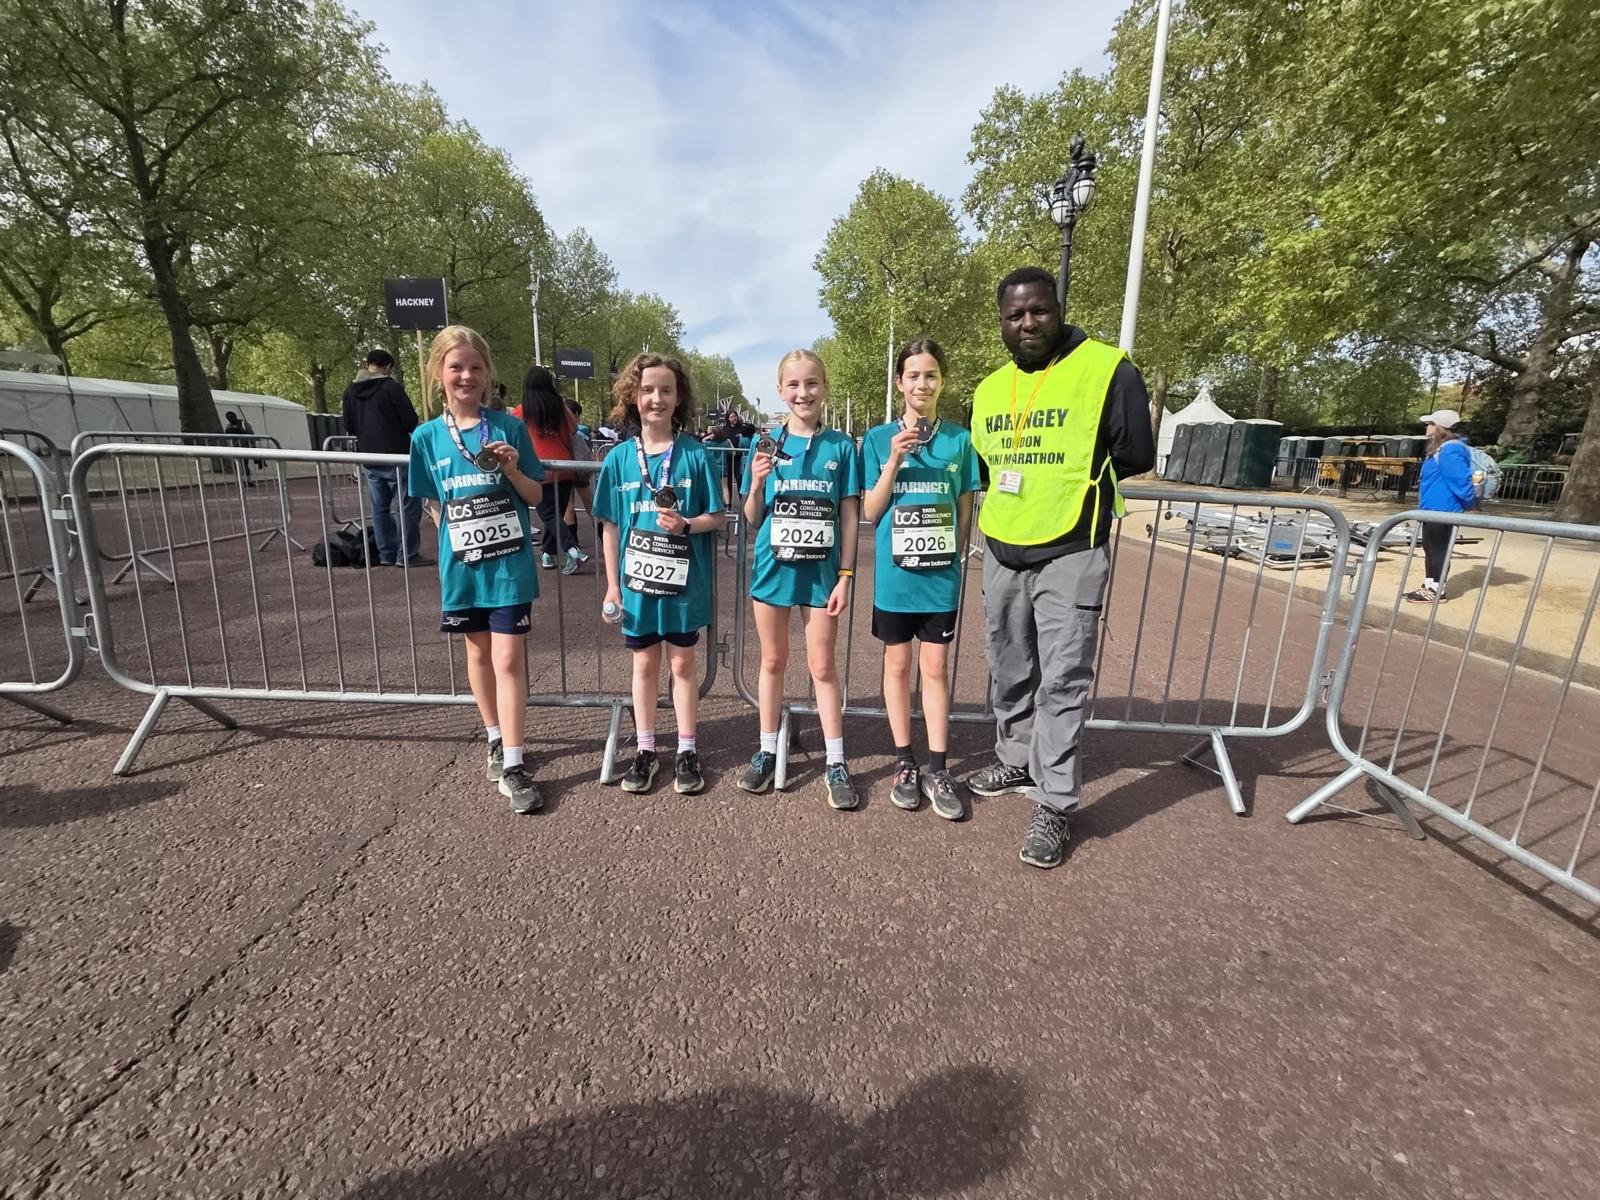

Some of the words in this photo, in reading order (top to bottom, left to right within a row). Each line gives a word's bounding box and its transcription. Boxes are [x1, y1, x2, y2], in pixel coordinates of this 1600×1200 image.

[395, 298, 434, 306] HACKNEY
[985, 408, 1069, 434] HARNGEY
[1001, 436, 1042, 449] LODON
[1003, 452, 1065, 465] MARATHON
[774, 480, 834, 493] HARINGEY
[893, 481, 950, 494] HARINGEY
[473, 498, 510, 509] CONSULTANCY
[774, 500, 797, 515] tcs
[447, 503, 472, 520] tcs
[475, 506, 500, 516] SERVICES
[894, 509, 920, 525] tcs
[461, 524, 511, 546] 2025
[629, 530, 650, 550] tcs
[653, 535, 669, 543] TATA
[780, 528, 824, 545] 2024
[651, 546, 675, 555] SERVICES
[652, 541, 688, 551] CONSULTANCY
[904, 536, 946, 552] 2026
[633, 561, 676, 581] 2027
